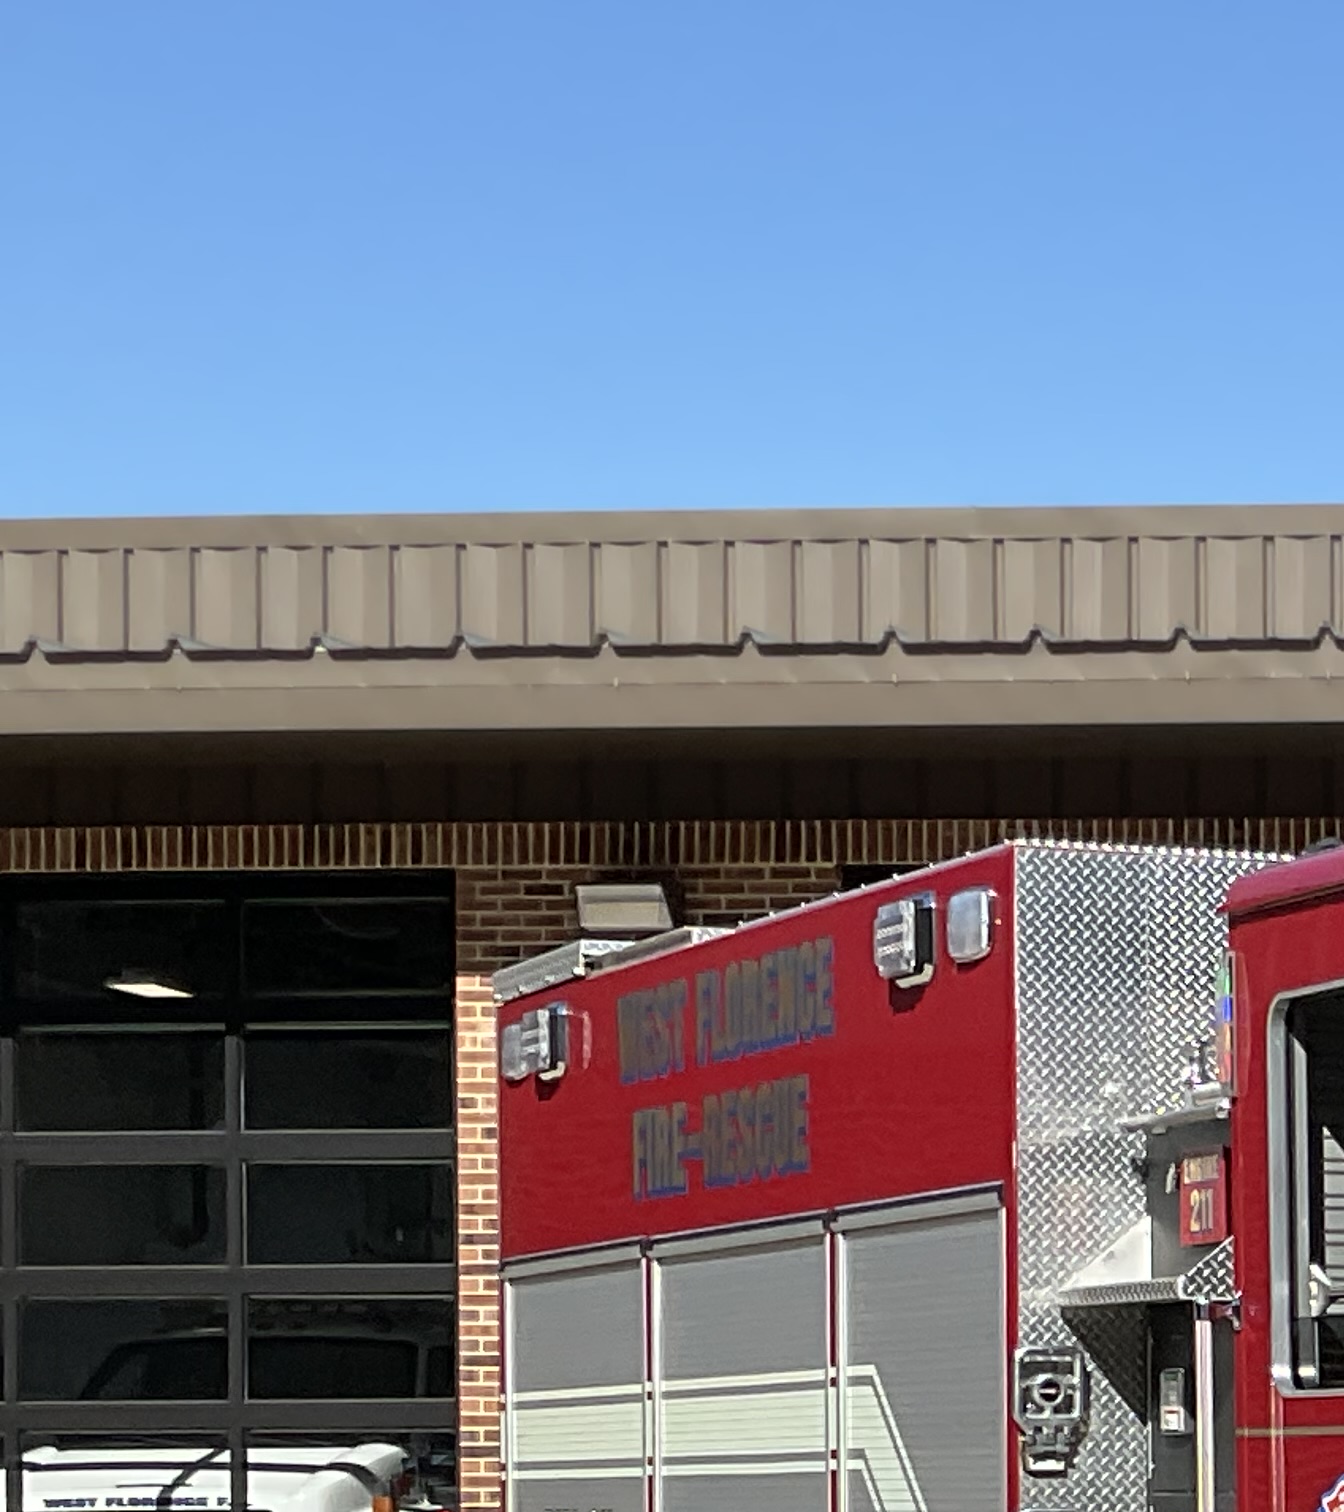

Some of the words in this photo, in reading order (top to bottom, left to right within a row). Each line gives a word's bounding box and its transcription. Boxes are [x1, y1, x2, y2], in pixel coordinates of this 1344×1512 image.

[617, 977, 688, 1084] WEST
[695, 936, 834, 1067] FLORENCE
[632, 1073, 809, 1202] FIRE-RESCUE
[1189, 1188, 1214, 1233] 211
[105, 1497, 209, 1507] FLORNCE
